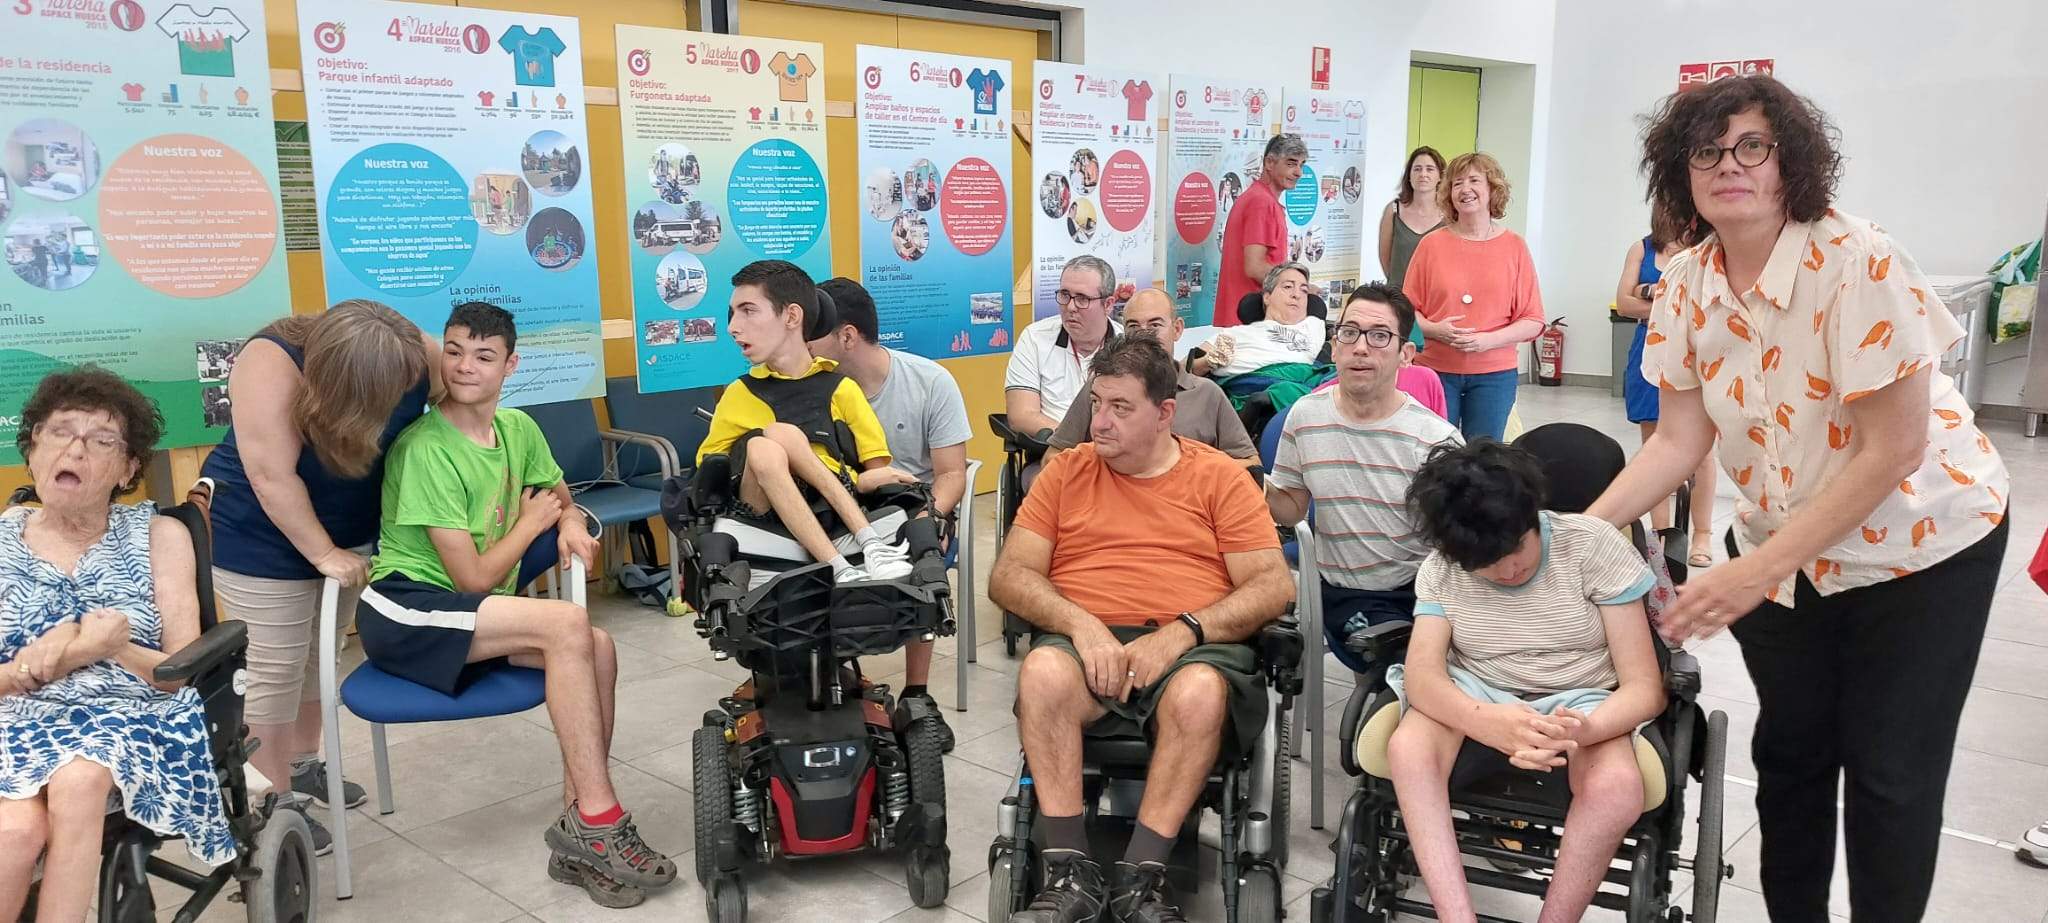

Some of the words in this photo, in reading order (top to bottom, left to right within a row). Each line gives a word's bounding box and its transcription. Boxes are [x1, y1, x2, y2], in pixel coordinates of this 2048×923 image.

[443, 45, 461, 53] 2016
[686, 44, 697, 64] 5
[18, 57, 32, 69] la
[37, 59, 112, 74] residencia
[317, 58, 369, 71] Objetivo:
[910, 61, 920, 82] 6
[319, 71, 358, 84] Parque
[361, 72, 402, 84] infantil
[404, 76, 454, 88] adaptado
[629, 79, 667, 90] Objetivo:
[1075, 74, 1085, 93] 7
[630, 91, 673, 102] Furgoneta
[675, 93, 712, 104] adaptada
[1204, 86, 1212, 103] 8
[864, 102, 889, 112] Ampliar
[914, 106, 941, 115] espacios
[1311, 98, 1317, 114] 9
[864, 112, 873, 120] de
[874, 112, 891, 121] taller
[901, 114, 908, 122] el
[908, 114, 928, 123] Centro
[144, 145, 197, 158] Nuestra
[200, 147, 224, 159] voz
[752, 147, 782, 157] Nuestra
[783, 149, 796, 157] voz
[364, 158, 408, 169] Nuestra
[410, 160, 430, 169] voz
[869, 265, 877, 273] La
[877, 263, 901, 273] opinión
[869, 274, 877, 282] de
[889, 272, 913, 281] familias
[450, 287, 461, 296] La
[463, 284, 501, 297] opinión
[450, 298, 463, 306] de
[486, 294, 522, 306] familias
